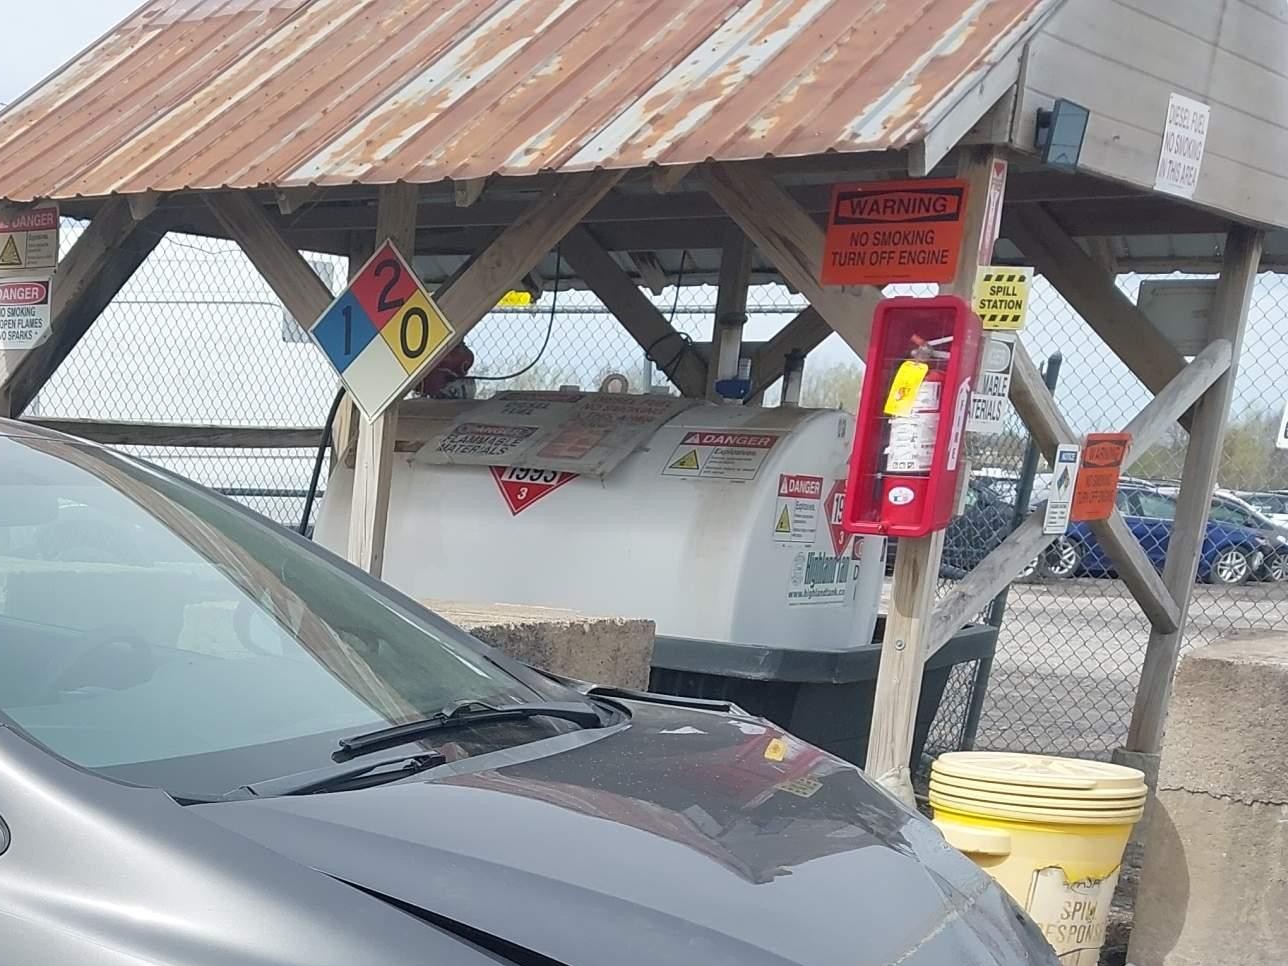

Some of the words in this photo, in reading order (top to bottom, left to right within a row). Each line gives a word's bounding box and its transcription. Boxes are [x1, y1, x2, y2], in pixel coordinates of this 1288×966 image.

[849, 196, 948, 217] WARNING
[849, 231, 870, 246] NO
[872, 230, 936, 246] SMOKING
[831, 251, 866, 267] TURN
[868, 250, 896, 266] OFF
[897, 249, 949, 265] ENGINE
[374, 258, 405, 312] 2
[989, 285, 1018, 297] SPILL
[6, 306, 36, 317] SMOKING
[978, 299, 1023, 310] STATION
[0, 318, 16, 329] OPEN
[17, 318, 43, 329] FLAMES
[342, 305, 353, 356] 1
[8, 329, 33, 341] SPARKS
[400, 306, 429, 359] 0
[442, 434, 523, 449] FLAMMABLE
[701, 434, 772, 446] DANGER
[439, 443, 510, 456] MATERIALS
[517, 487, 528, 500] 3
[789, 478, 820, 495] DANGER
[839, 530, 845, 545] 3
